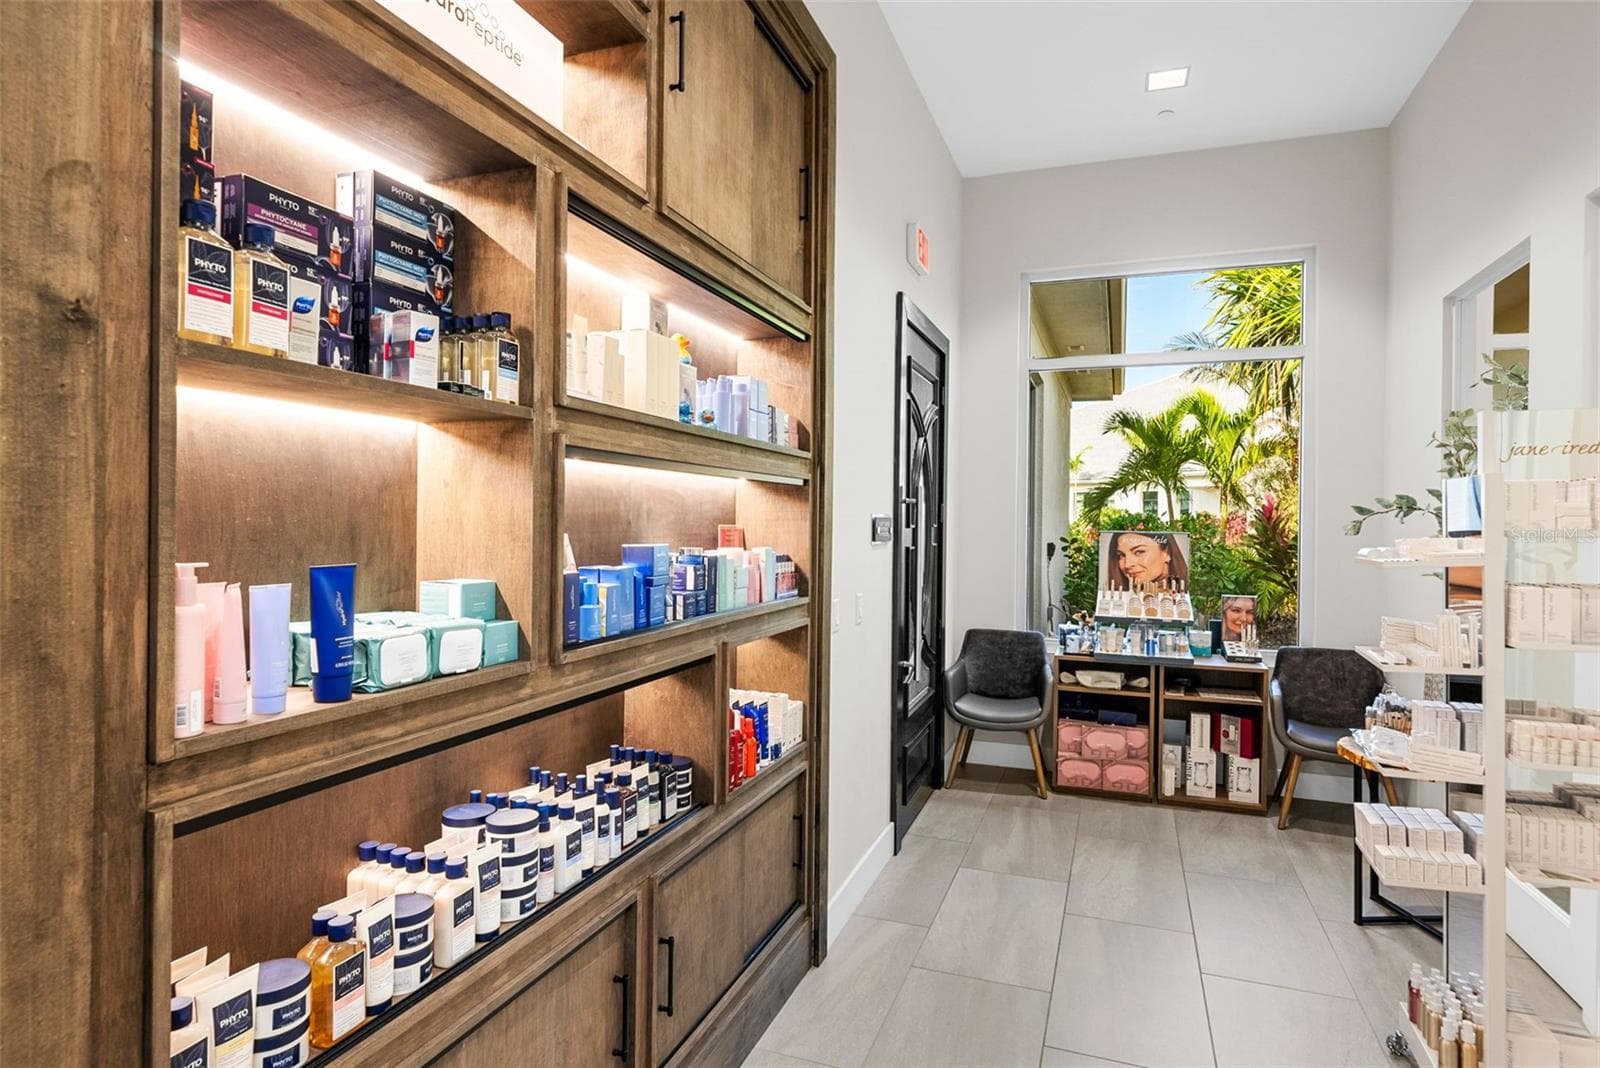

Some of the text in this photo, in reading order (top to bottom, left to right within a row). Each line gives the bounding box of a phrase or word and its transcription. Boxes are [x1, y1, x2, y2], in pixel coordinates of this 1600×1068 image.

[269, 193, 300, 211] PHYTO
[260, 208, 308, 230] PHYTOCYANE
[194, 258, 227, 274] PHYTO
[257, 278, 284, 292] PHYTO
[1500, 441, 1549, 463] jane
[373, 928, 391, 944] PHYTO
[338, 967, 361, 986] PHYTO
[219, 1008, 249, 1029] PHYTO
